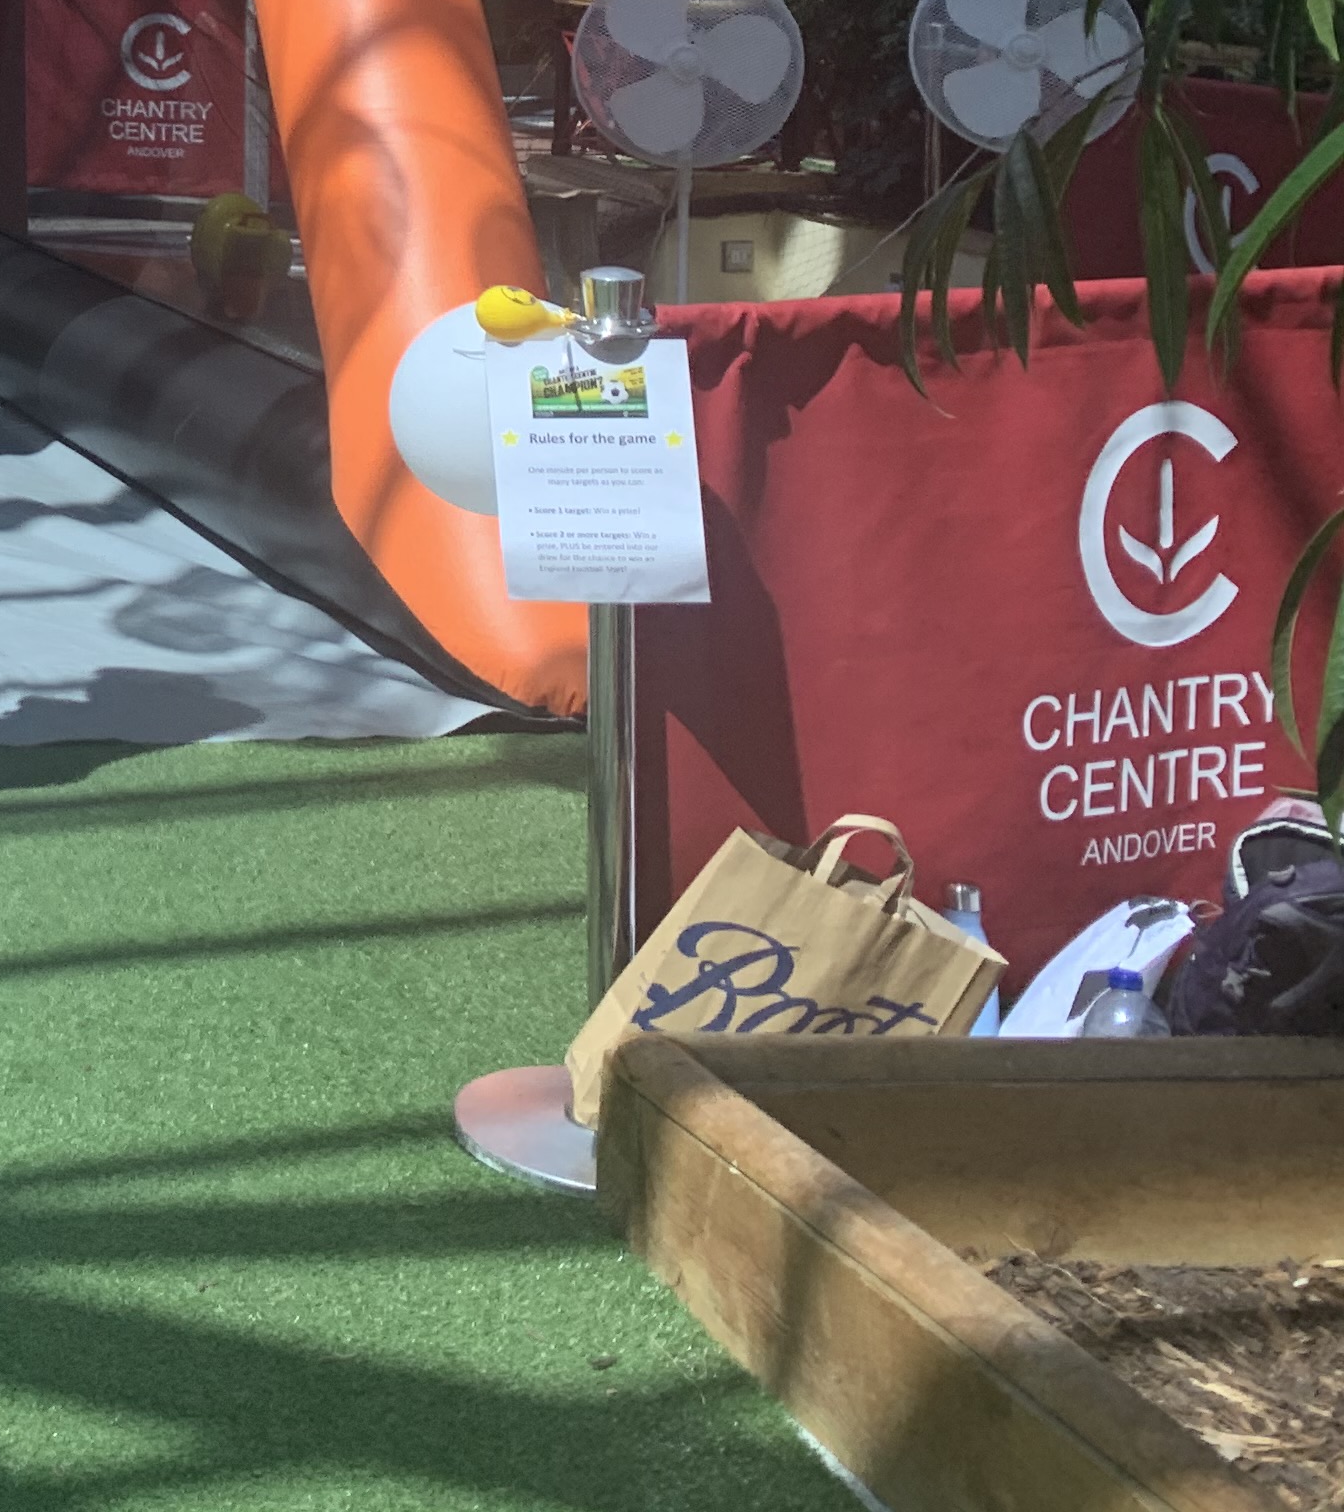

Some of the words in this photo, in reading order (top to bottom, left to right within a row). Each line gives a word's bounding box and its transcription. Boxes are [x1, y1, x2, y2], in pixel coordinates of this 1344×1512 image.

[101, 98, 214, 121] CHANTRY
[109, 121, 205, 143] CENTRE
[127, 145, 185, 159] ANDOVER
[529, 432, 565, 445] Rules
[569, 432, 589, 445] for
[593, 432, 614, 445] the
[619, 434, 657, 447] game
[534, 507, 556, 515] Score
[565, 507, 591, 517] target:
[593, 507, 610, 515] Win
[536, 531, 557, 539] Score
[633, 531, 650, 539] Win
[1022, 670, 1277, 752] CHANTRY
[1039, 741, 1267, 822] CENTRE
[1080, 821, 1217, 866] ANDOVER
